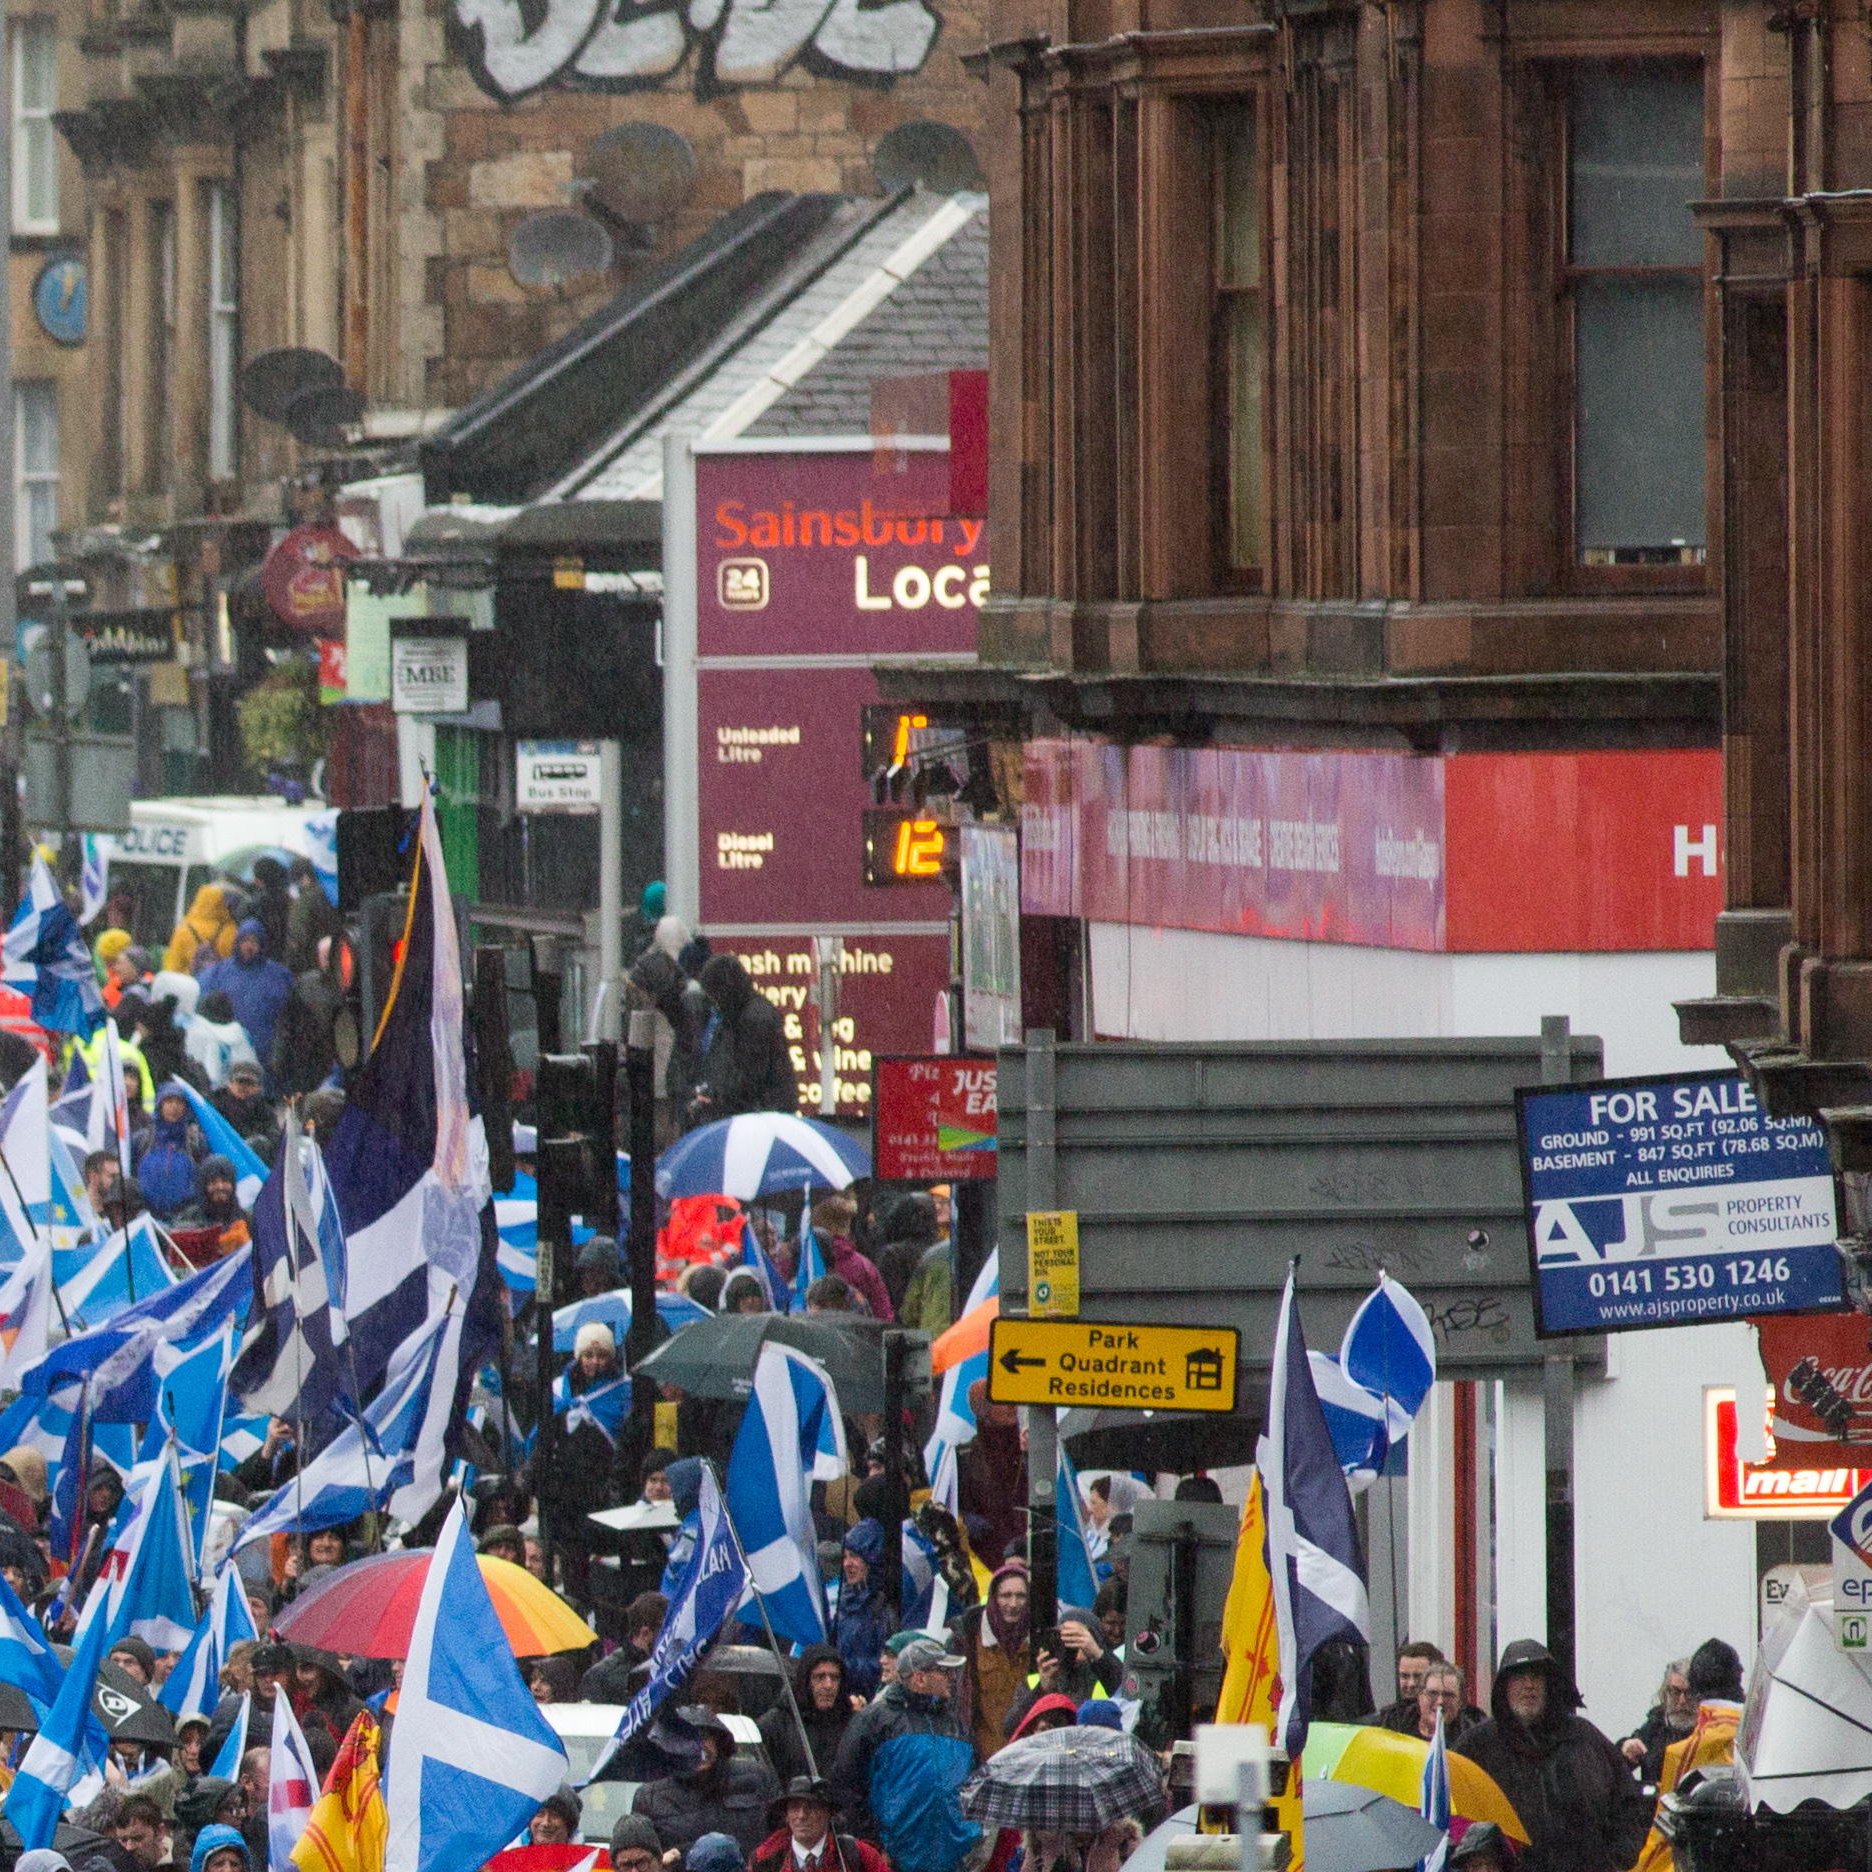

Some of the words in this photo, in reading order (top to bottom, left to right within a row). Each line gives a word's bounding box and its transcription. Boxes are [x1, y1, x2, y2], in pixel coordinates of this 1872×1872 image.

[726, 567, 760, 589] 24
[717, 726, 800, 744] Unleaded
[718, 747, 762, 763] Litre
[528, 788, 553, 798] Bus
[559, 787, 592, 799] Stop
[118, 829, 188, 857] OLICE
[717, 832, 773, 851] Diesel
[718, 852, 763, 869] Litre
[784, 1013, 803, 1039] &
[1590, 1091, 1658, 1125] FOR
[1674, 1082, 1757, 1118] SALE
[1541, 1130, 1609, 1150] GROUND
[1630, 1125, 1656, 1141] 991
[1661, 1122, 1705, 1141] SQ.FT
[1712, 1119, 1758, 1137] (92.06
[1533, 1151, 1616, 1171] BASEMENT
[1638, 1147, 1666, 1162] 847
[1672, 1142, 1715, 1160] SQ.FT
[1722, 1138, 1770, 1157] (78.68
[1776, 1132, 1824, 1150] SQ.M)
[1626, 1171, 1653, 1186] ALL
[1659, 1164, 1735, 1183] ENQUIRIES
[1727, 1195, 1803, 1215] PROPERTY
[1034, 1228, 1056, 1236] YOUR
[1532, 1193, 1720, 1268] AJS
[1728, 1213, 1831, 1235] CONSULTANTS
[1034, 1250, 1050, 1258] NOT
[1053, 1249, 1075, 1257] YOUR
[1034, 1259, 1075, 1267] PERSONAL
[1589, 1271, 1653, 1297] 0141
[1664, 1265, 1715, 1290] 530
[1726, 1258, 1791, 1285] 1246
[1599, 1288, 1786, 1319] www.ajsproperty.co.uk
[1089, 1330, 1139, 1349] Park
[1059, 1353, 1166, 1375] Quadrant
[1048, 1377, 1175, 1400] Residences
[1745, 1469, 1847, 1494] mail
